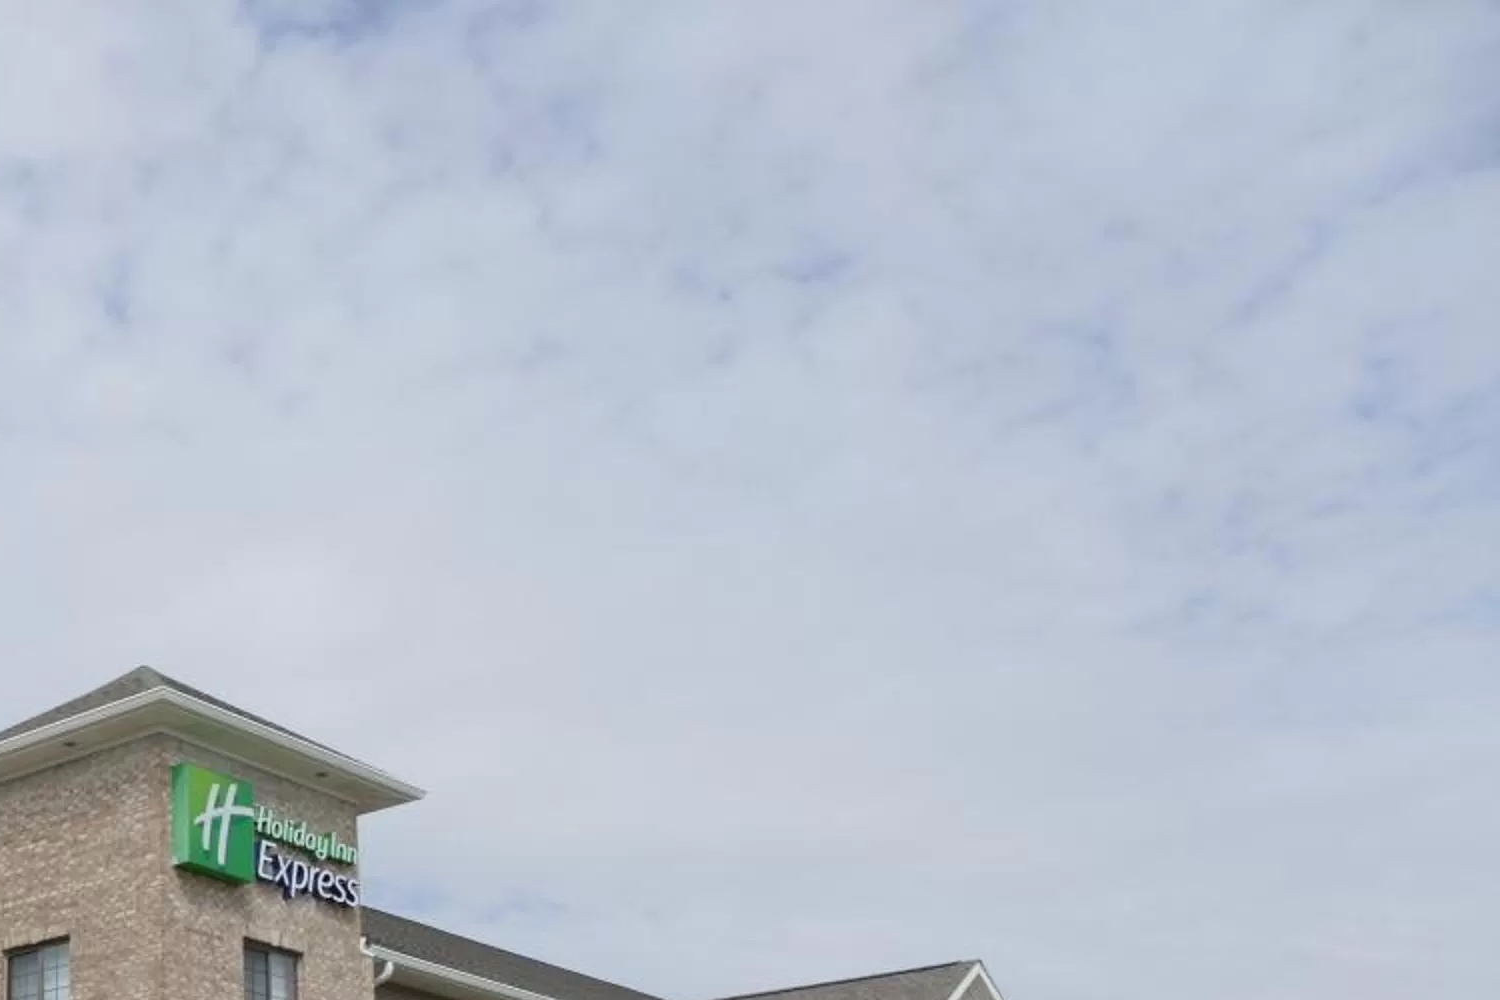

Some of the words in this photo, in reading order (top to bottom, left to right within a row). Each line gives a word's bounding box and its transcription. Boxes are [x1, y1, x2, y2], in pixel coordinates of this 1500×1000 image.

[193, 783, 256, 865] H
[257, 806, 329, 860] Holiday
[330, 832, 357, 865] Inn
[258, 839, 360, 906] Express
